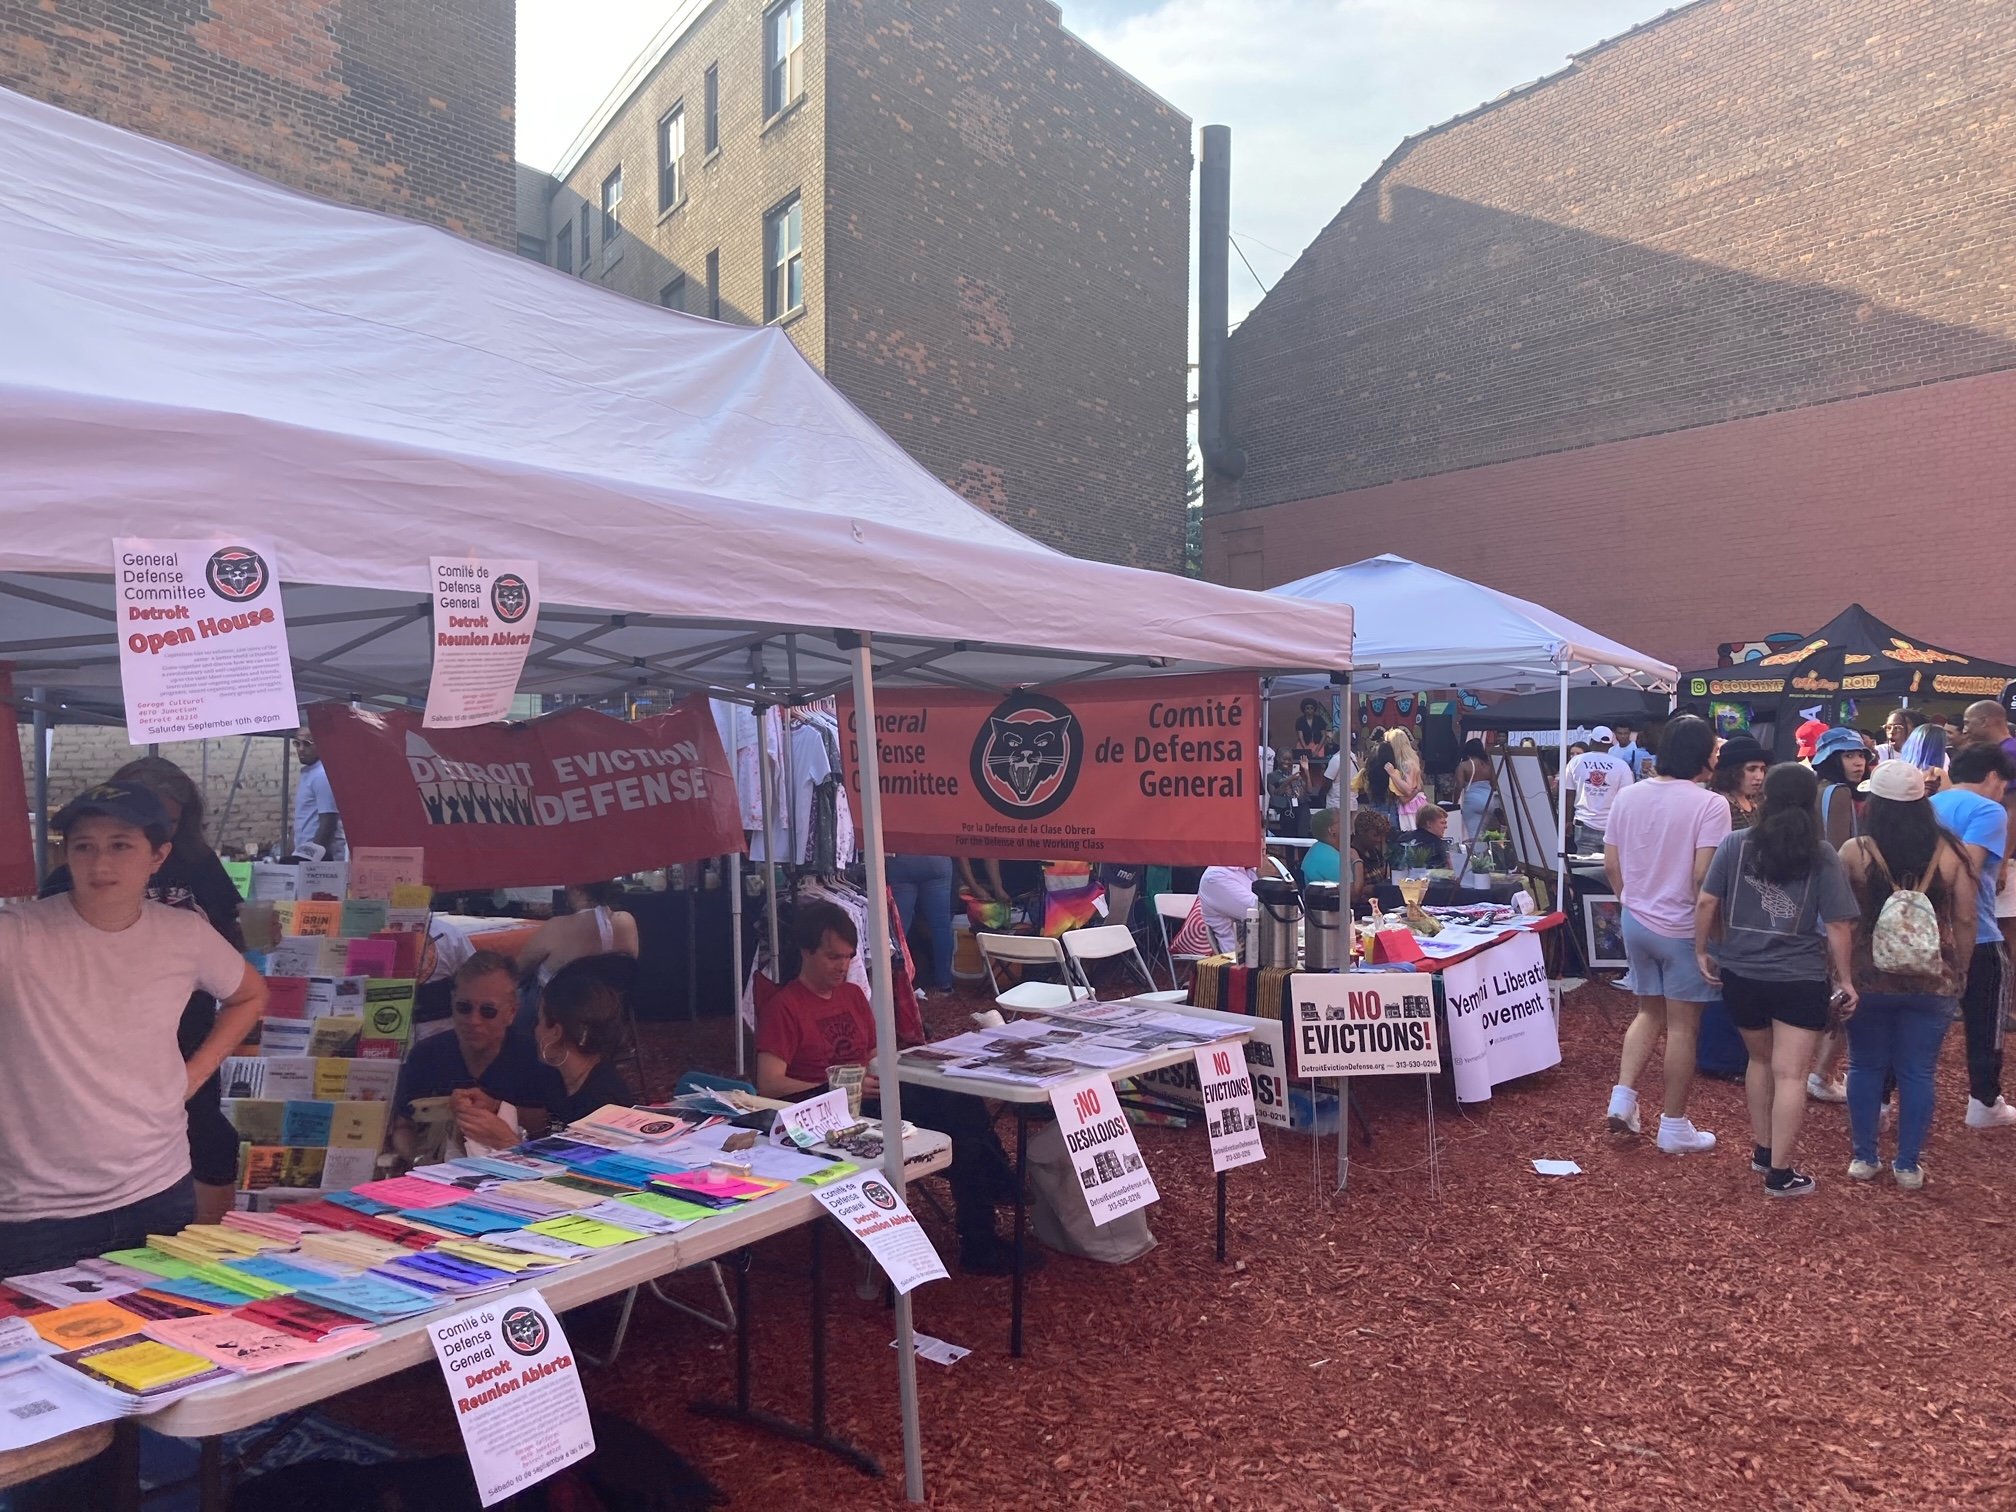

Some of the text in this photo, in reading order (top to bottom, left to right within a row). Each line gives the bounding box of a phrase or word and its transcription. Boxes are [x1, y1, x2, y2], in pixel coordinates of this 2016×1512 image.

[122, 553, 178, 566] General
[438, 565, 489, 578] Comité de
[124, 570, 184, 583] Defense
[439, 582, 482, 593] Defensa
[124, 587, 206, 600] Committee
[440, 597, 480, 609] General
[129, 604, 190, 620] Detroit
[449, 616, 488, 628] Detroit
[128, 608, 275, 654] Open House
[438, 632, 531, 646] Reunion Abierta
[148, 714, 281, 735] Saturday September 10th @2pm
[847, 708, 927, 734] Gneral
[1149, 698, 1242, 729] Comité
[850, 738, 926, 764] Dfense
[1095, 735, 1242, 764] de Defensa
[407, 739, 700, 787] DETROIT EVICTION
[1584, 761, 1614, 770] VANS
[852, 770, 958, 796] Cmmittee
[1140, 770, 1243, 798] General
[535, 767, 706, 827] DEFENSE
[962, 822, 1096, 836] Por la Defensa de la Clase Obrera
[955, 836, 1105, 852] For the Defense of the Working Class
[1348, 990, 1382, 1021] NO
[1302, 1022, 1432, 1055] EVICTIONS!
[1212, 1051, 1231, 1076] NO
[1301, 1062, 1386, 1073] DetroitEvictionDefense.org
[1396, 1060, 1438, 1070] 313-530-0216
[1204, 1076, 1251, 1104] EVICTIONS!
[794, 1100, 833, 1130] GET IN
[1066, 1116, 1129, 1154] DESALOJOS!
[828, 1192, 860, 1208] Defensa
[838, 1200, 866, 1216] General
[853, 1210, 881, 1224] Detroit
[855, 1220, 892, 1238] Reunion
[438, 1312, 495, 1342] Comité de
[443, 1331, 492, 1357] Defensa
[450, 1344, 496, 1372] General
[457, 1354, 573, 1414] Reunion Abierta
[465, 1360, 513, 1389] Detroit
